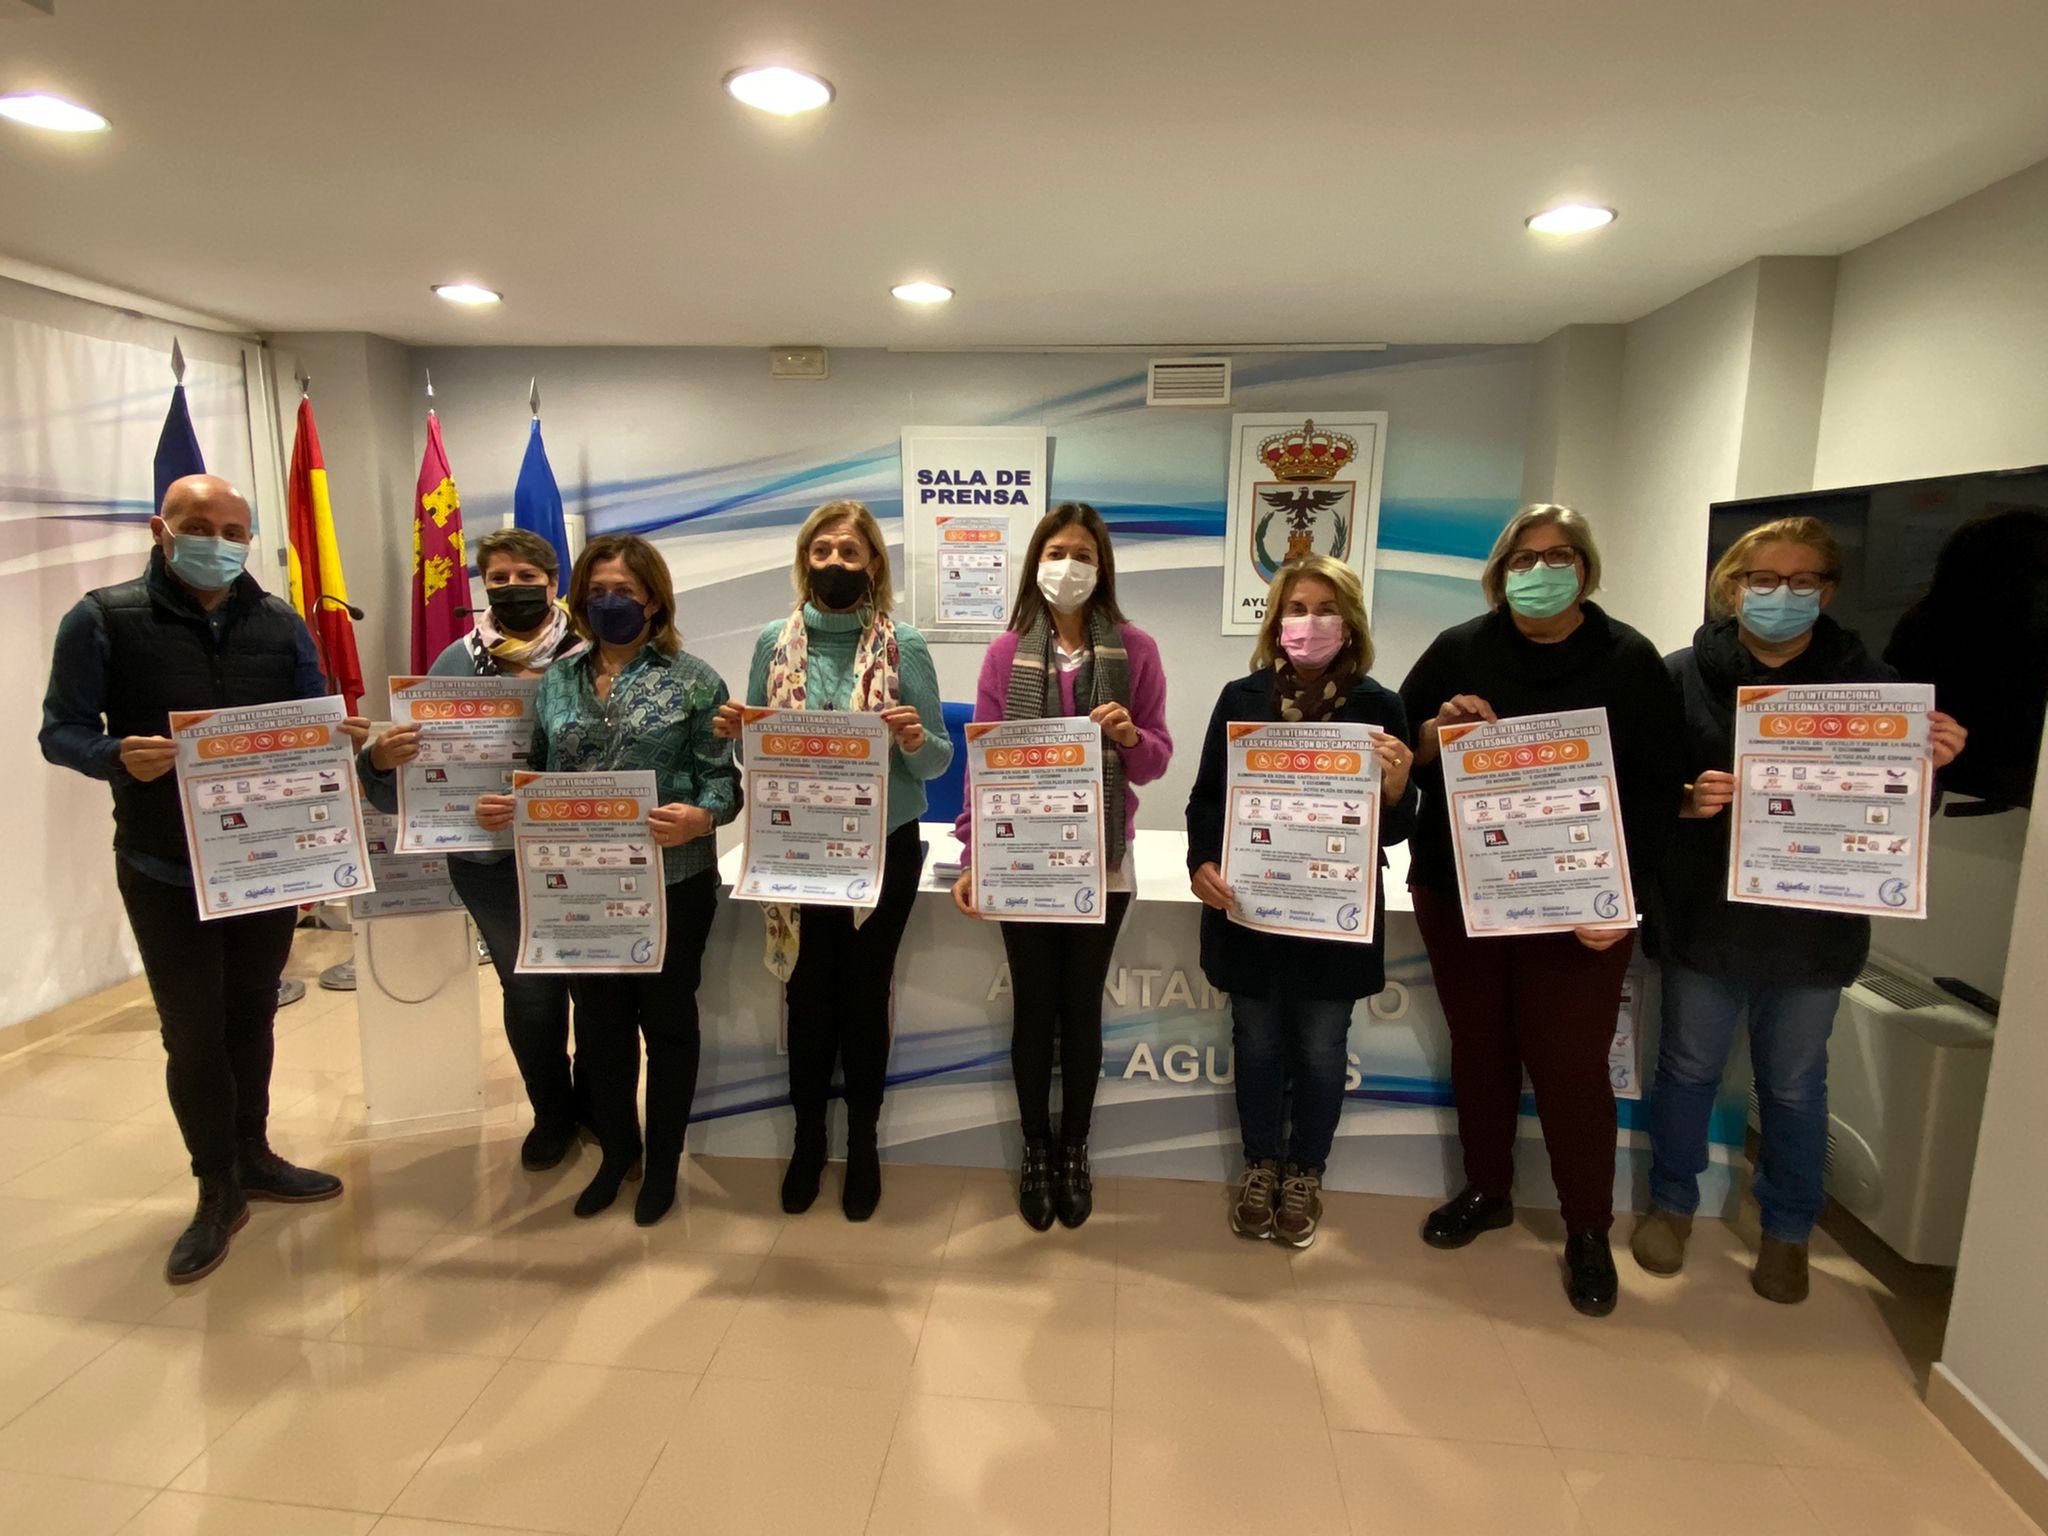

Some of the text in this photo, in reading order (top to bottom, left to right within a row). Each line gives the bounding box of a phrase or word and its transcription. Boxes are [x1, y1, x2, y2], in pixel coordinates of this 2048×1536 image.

[917, 469, 1031, 486] SALA DE
[920, 489, 1029, 505] PRENSA
[1242, 598, 1267, 607] AYU
[1789, 691, 1880, 700] DIA INTERNACIONAL
[1747, 704, 1758, 712] DE
[1759, 704, 1776, 712] LAS
[1778, 704, 1825, 712] PERSONAS
[1827, 704, 1848, 712] CON
[1483, 720, 1560, 736] DIA INTERNACIONAL
[1449, 742, 1460, 751] DE
[1461, 741, 1474, 750] LAS
[1476, 736, 1516, 748] PERSONAS
[1517, 734, 1535, 744] CON
